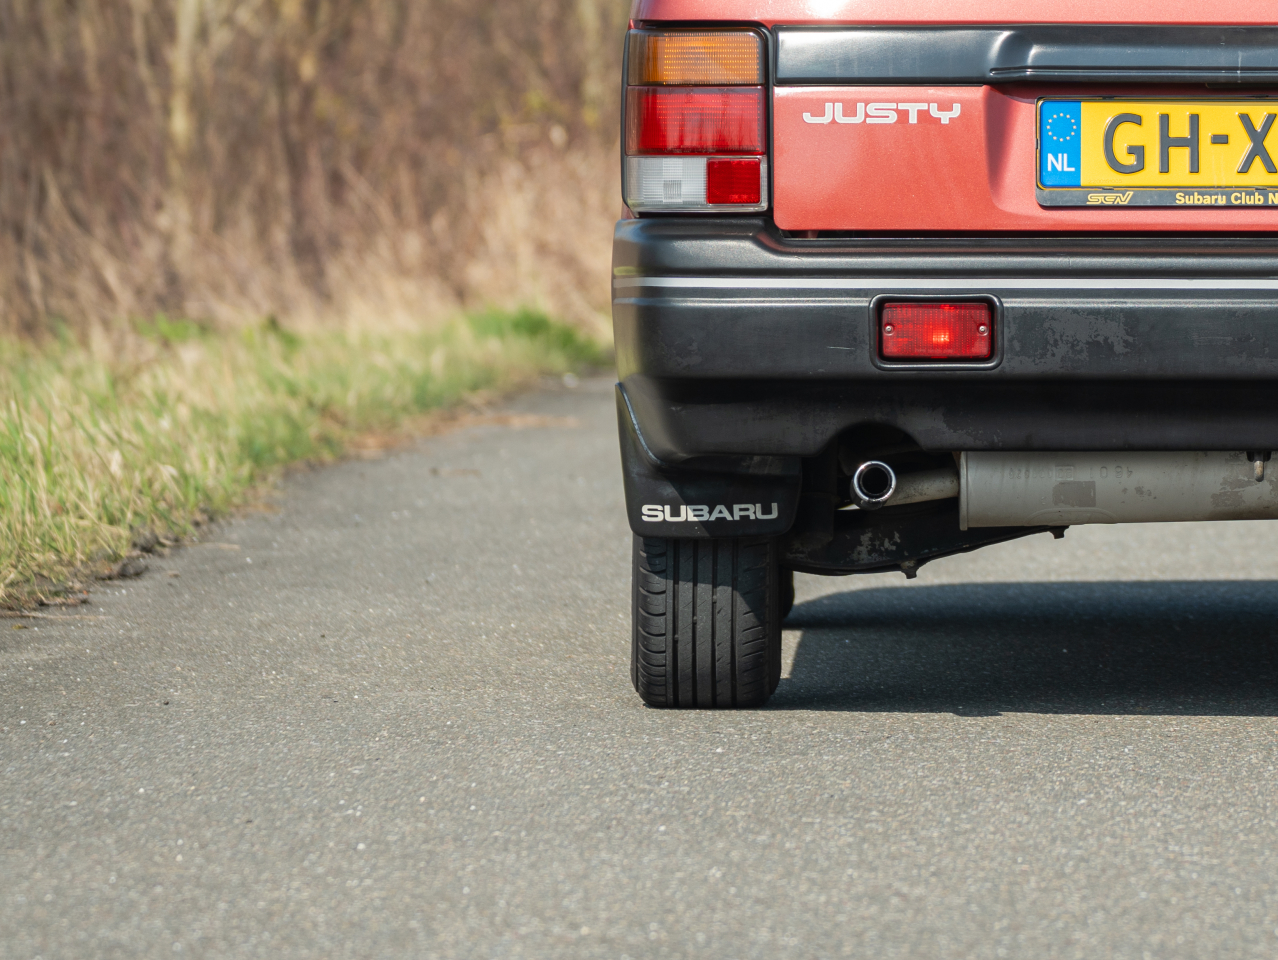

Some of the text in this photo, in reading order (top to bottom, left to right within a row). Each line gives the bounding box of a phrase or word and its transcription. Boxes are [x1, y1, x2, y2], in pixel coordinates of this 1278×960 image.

[802, 102, 961, 124] JUSTY
[1047, 153, 1076, 172] NL
[1175, 192, 1227, 205] Subaru
[1230, 192, 1264, 205] Club
[641, 502, 779, 522] SUBARU
